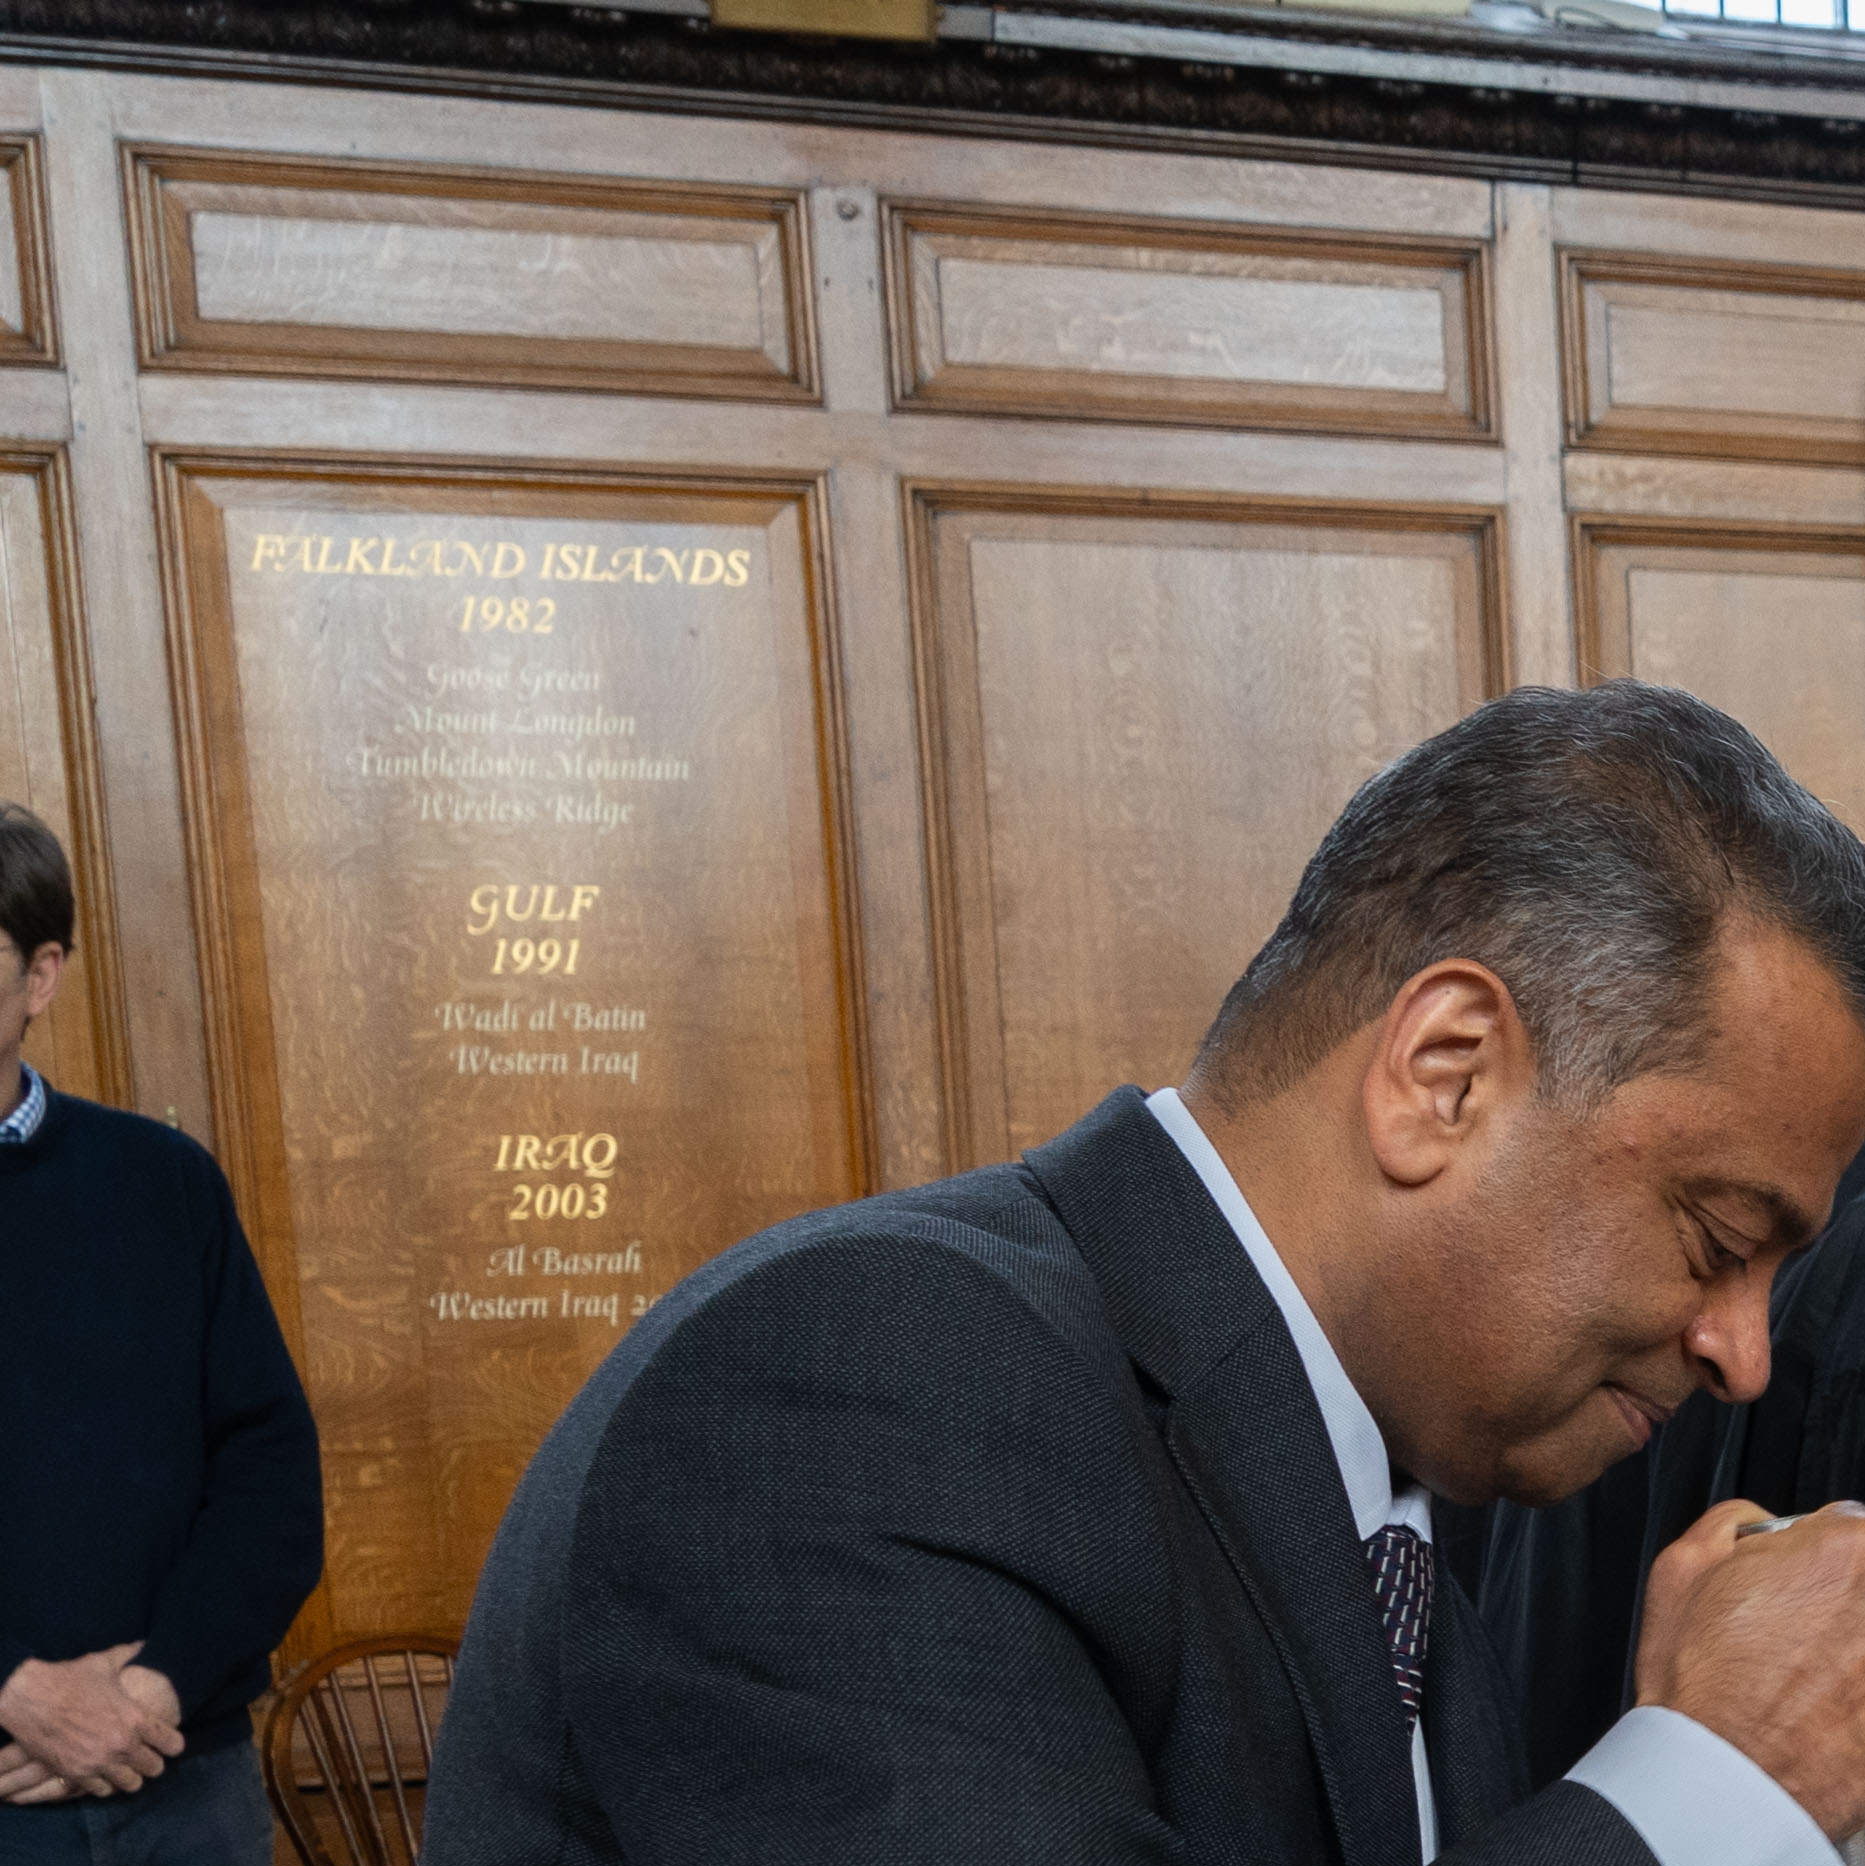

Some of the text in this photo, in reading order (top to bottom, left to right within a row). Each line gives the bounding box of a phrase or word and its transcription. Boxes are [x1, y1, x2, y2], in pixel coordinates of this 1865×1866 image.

[250, 533, 752, 588] FALKLAND ISLANDS
[459, 595, 556, 634] 1982
[519, 663, 604, 696] Green
[394, 704, 637, 741] Mount Longdon
[354, 744, 690, 782] Tumbledown Mountain
[411, 789, 635, 833] Wireless Ridge
[466, 884, 601, 937] GULF
[490, 937, 582, 976] 1991
[433, 1000, 647, 1033] Wadi al Batin
[448, 1046, 640, 1084] Western Iraq
[493, 1133, 618, 1179] IRAQ
[509, 1182, 608, 1221] 2003
[486, 1240, 643, 1278] Al Basrah
[429, 1290, 549, 1322] Western
[559, 1289, 620, 1327] Iraq
